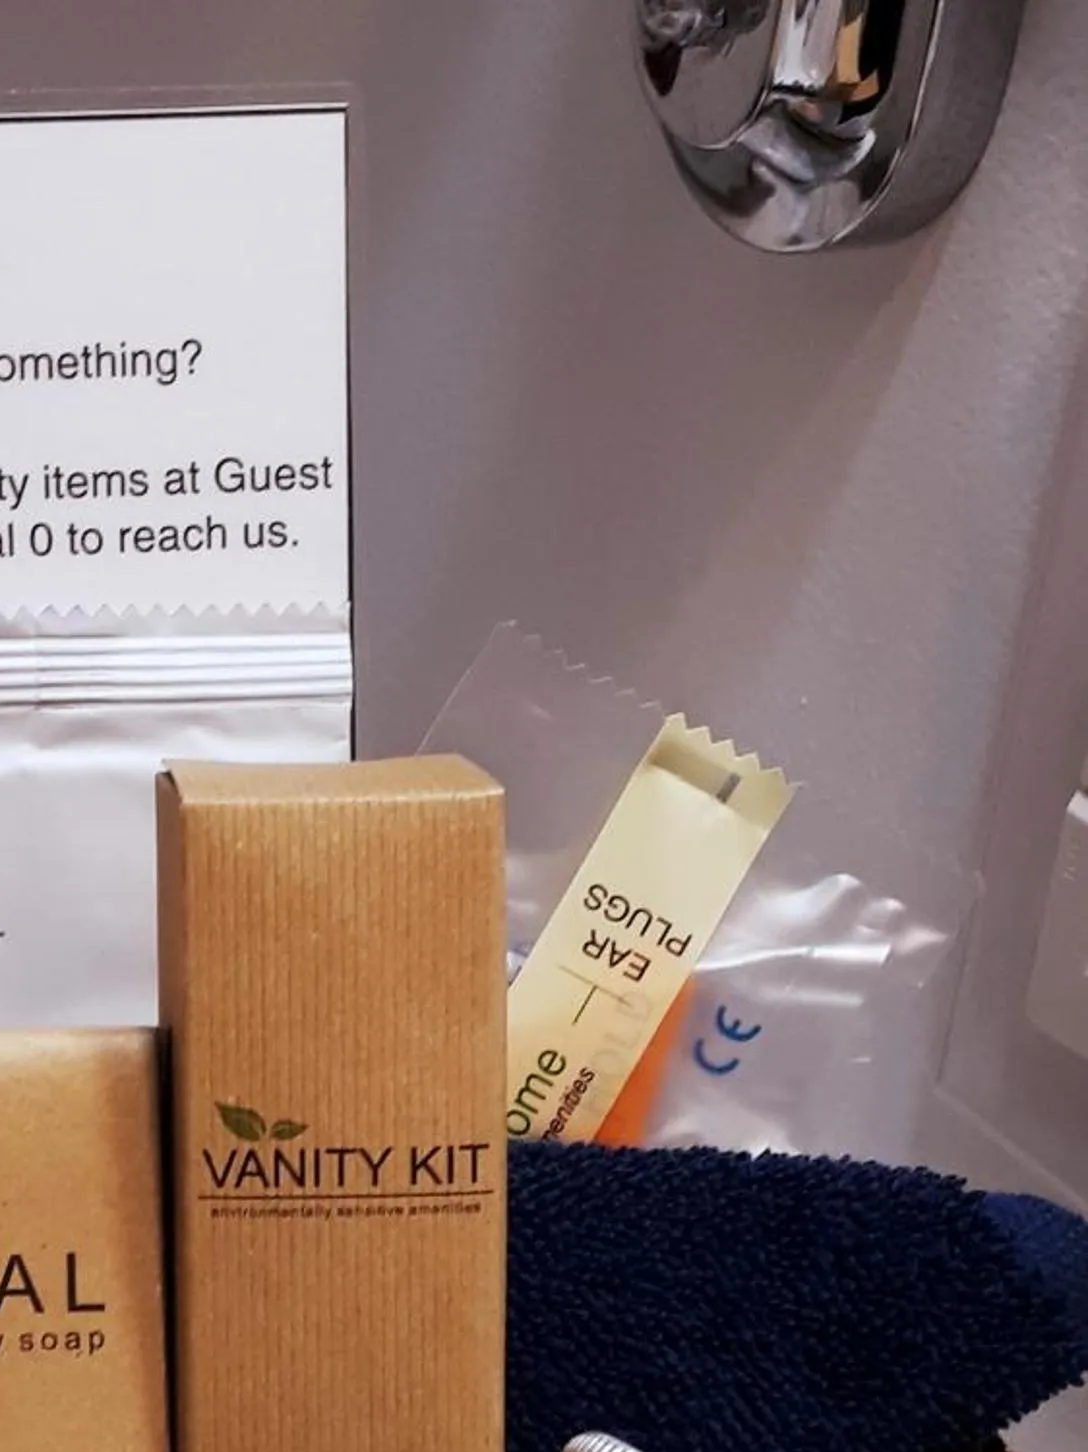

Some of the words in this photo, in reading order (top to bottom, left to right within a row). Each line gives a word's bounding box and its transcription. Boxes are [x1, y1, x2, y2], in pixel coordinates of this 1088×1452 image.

[43, 465, 149, 501] items
[164, 461, 201, 495] at
[214, 455, 334, 493] Guest
[28, 523, 53, 558] 0
[67, 522, 104, 557] to
[118, 515, 227, 553] reach
[243, 516, 300, 550] us.
[584, 884, 693, 958] PLUGS
[582, 929, 652, 983] EAR
[203, 1147, 392, 1189] VANITY
[411, 1144, 490, 1186] KIT
[18, 1328, 106, 1358] soap
